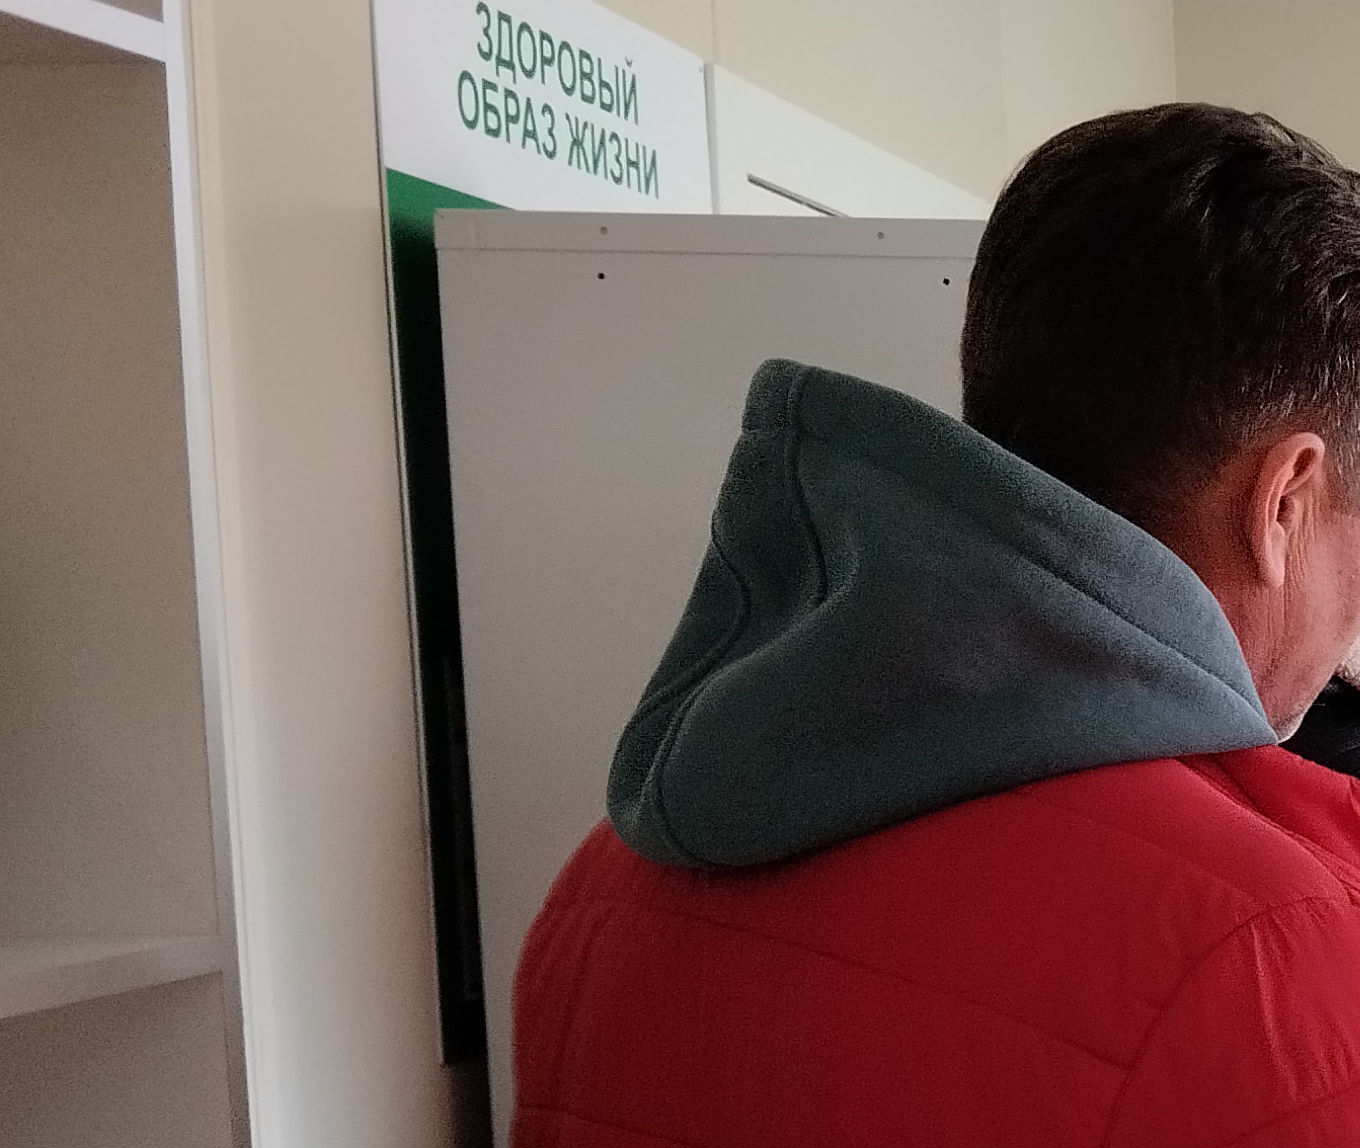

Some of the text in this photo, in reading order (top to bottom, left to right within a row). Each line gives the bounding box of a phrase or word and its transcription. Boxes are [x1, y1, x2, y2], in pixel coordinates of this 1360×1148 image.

[476, 1, 638, 125] ЗДОРОВЫЙ
[458, 70, 659, 199] ОБРАЗ ЖИЗНИ
